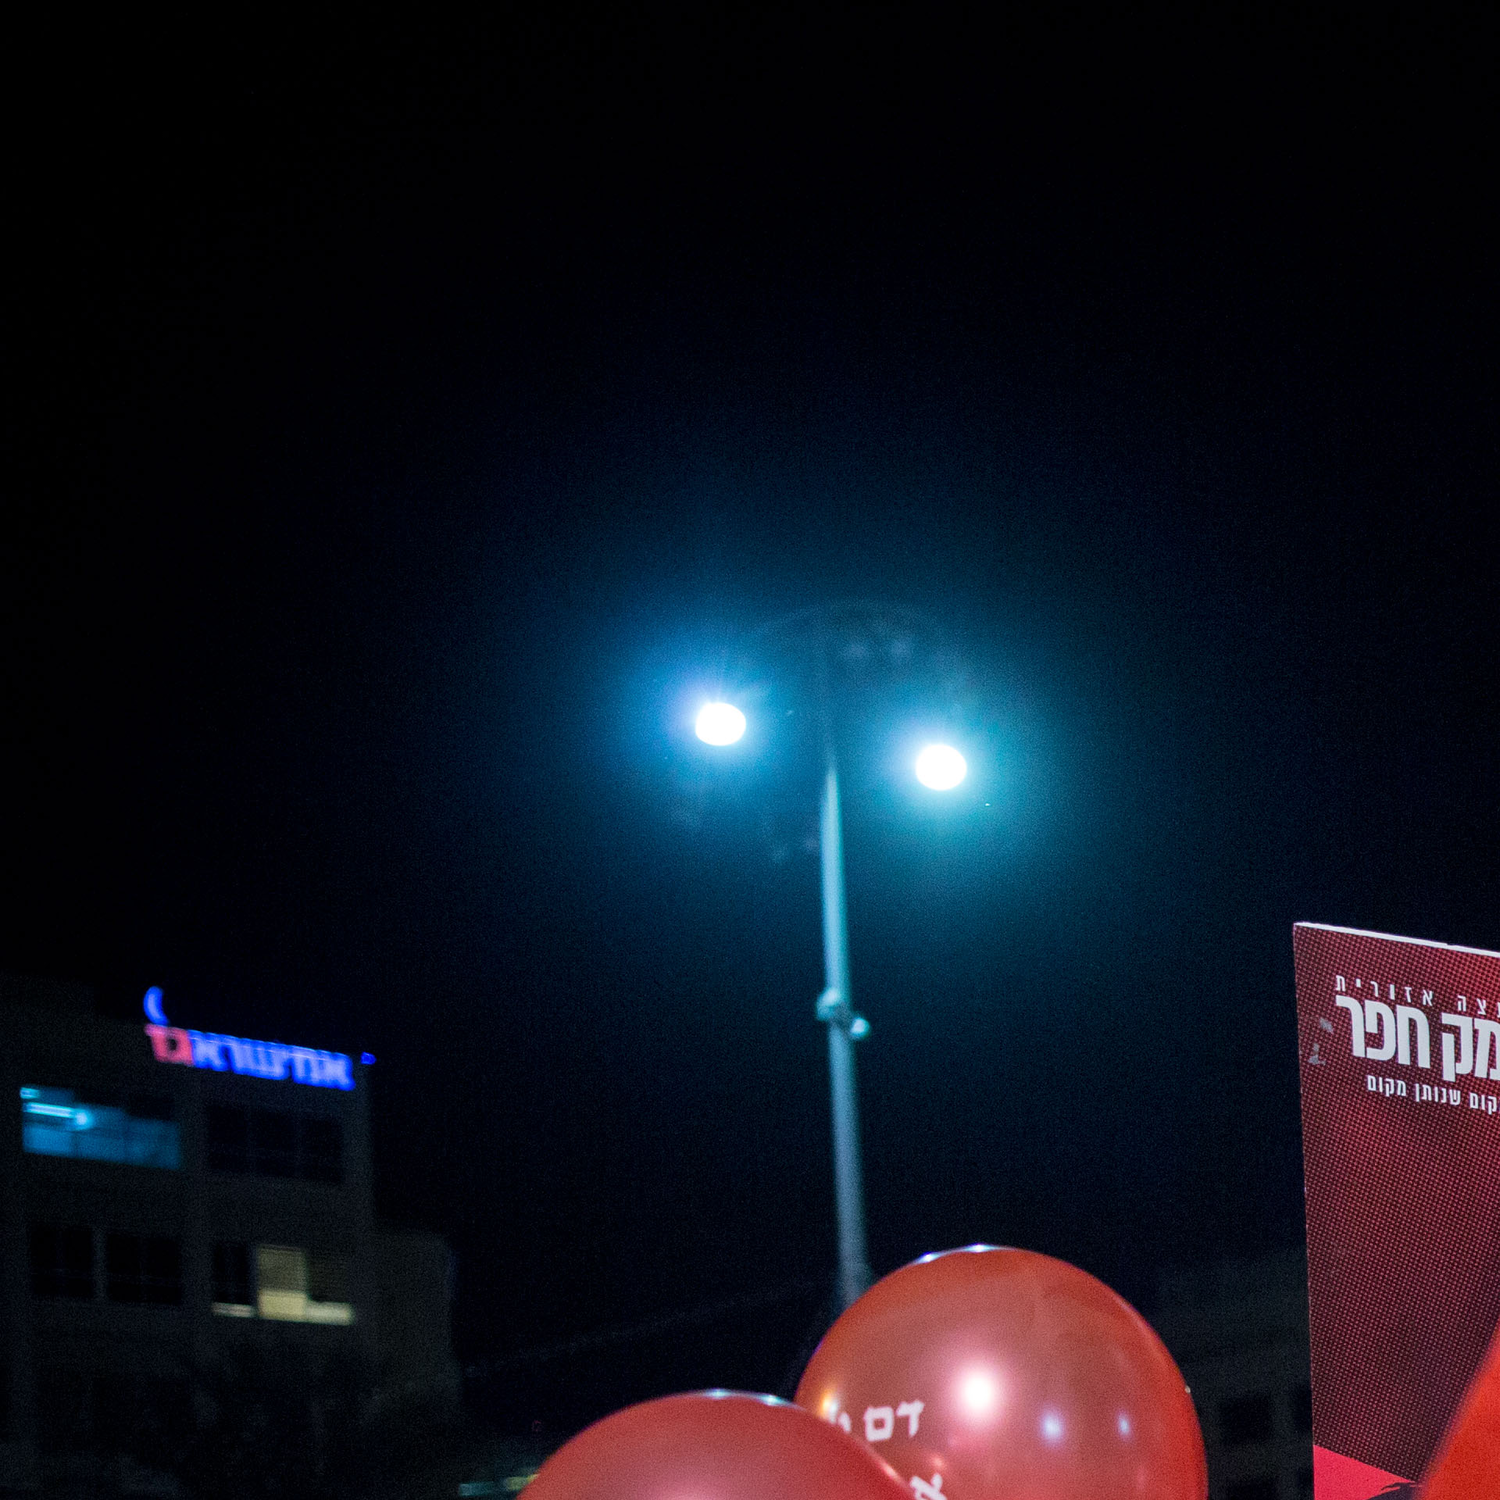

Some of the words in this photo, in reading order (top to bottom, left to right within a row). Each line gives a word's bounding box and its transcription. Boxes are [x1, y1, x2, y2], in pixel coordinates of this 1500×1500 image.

[1336, 974, 1434, 1007] אזורית
[1335, 994, 1431, 1069] חפר
[1366, 1074, 1407, 1098] מקום
[1414, 1083, 1462, 1106] שנותן
[864, 1399, 925, 1442] דם
